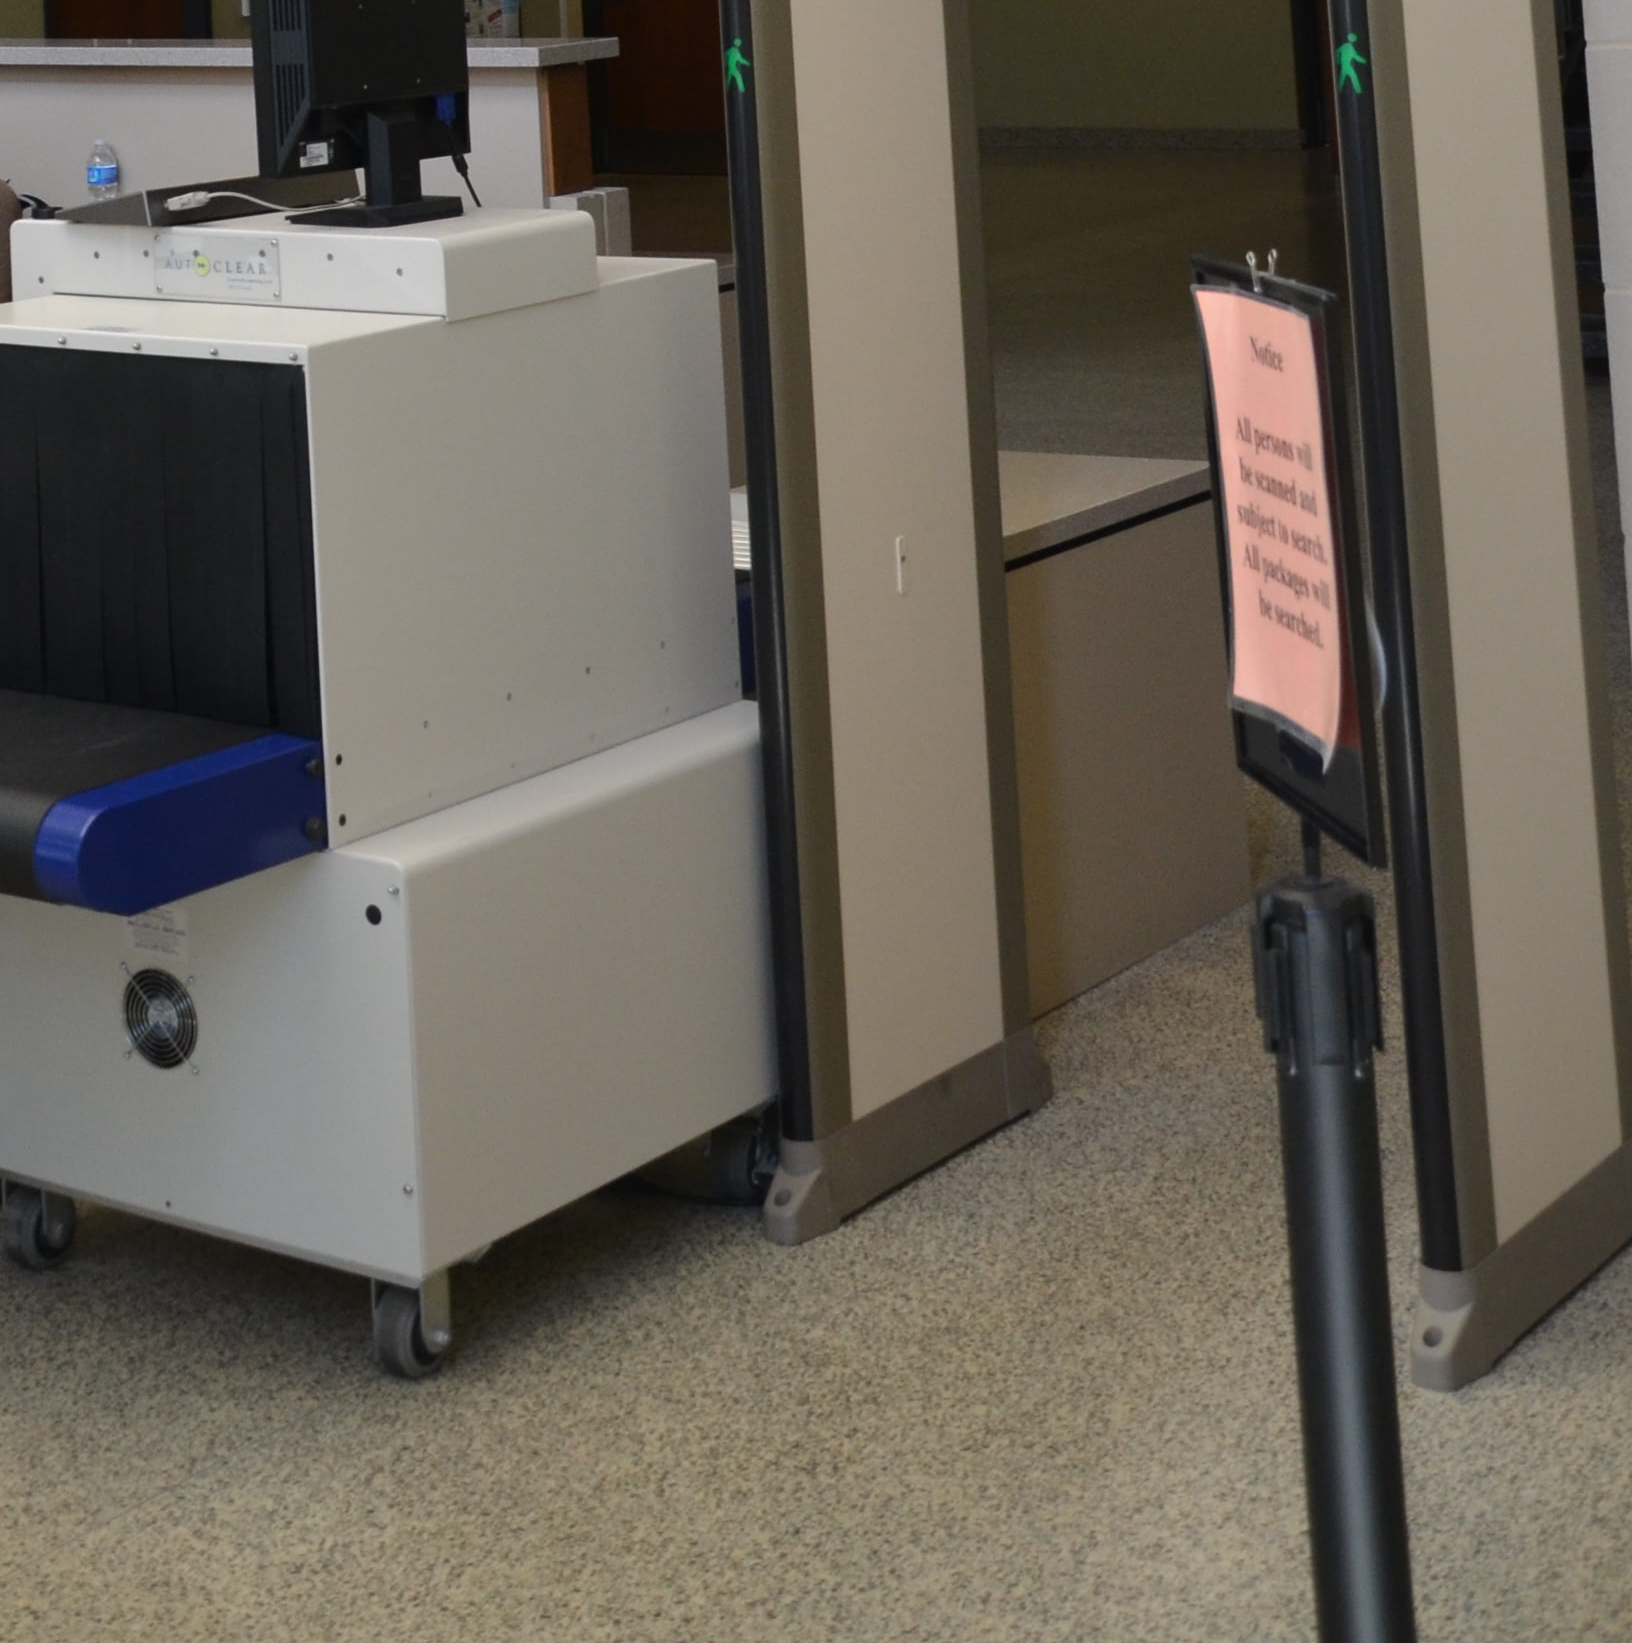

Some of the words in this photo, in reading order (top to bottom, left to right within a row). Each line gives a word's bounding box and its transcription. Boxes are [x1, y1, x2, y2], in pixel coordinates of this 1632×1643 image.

[1249, 335, 1284, 372] Notice
[1235, 416, 1252, 444] All
[1254, 427, 1295, 462] persons
[1296, 441, 1313, 471] will
[1239, 456, 1253, 485] be
[1255, 471, 1297, 506] scanned
[1298, 489, 1318, 518] and
[1237, 502, 1276, 538] subject
[1277, 520, 1290, 545] to
[1291, 529, 1328, 565] search.
[1244, 544, 1260, 572] All
[1262, 557, 1310, 602] packages
[1311, 579, 1331, 611] will
[1258, 588, 1272, 620] be
[1274, 604, 1324, 649] searched.
